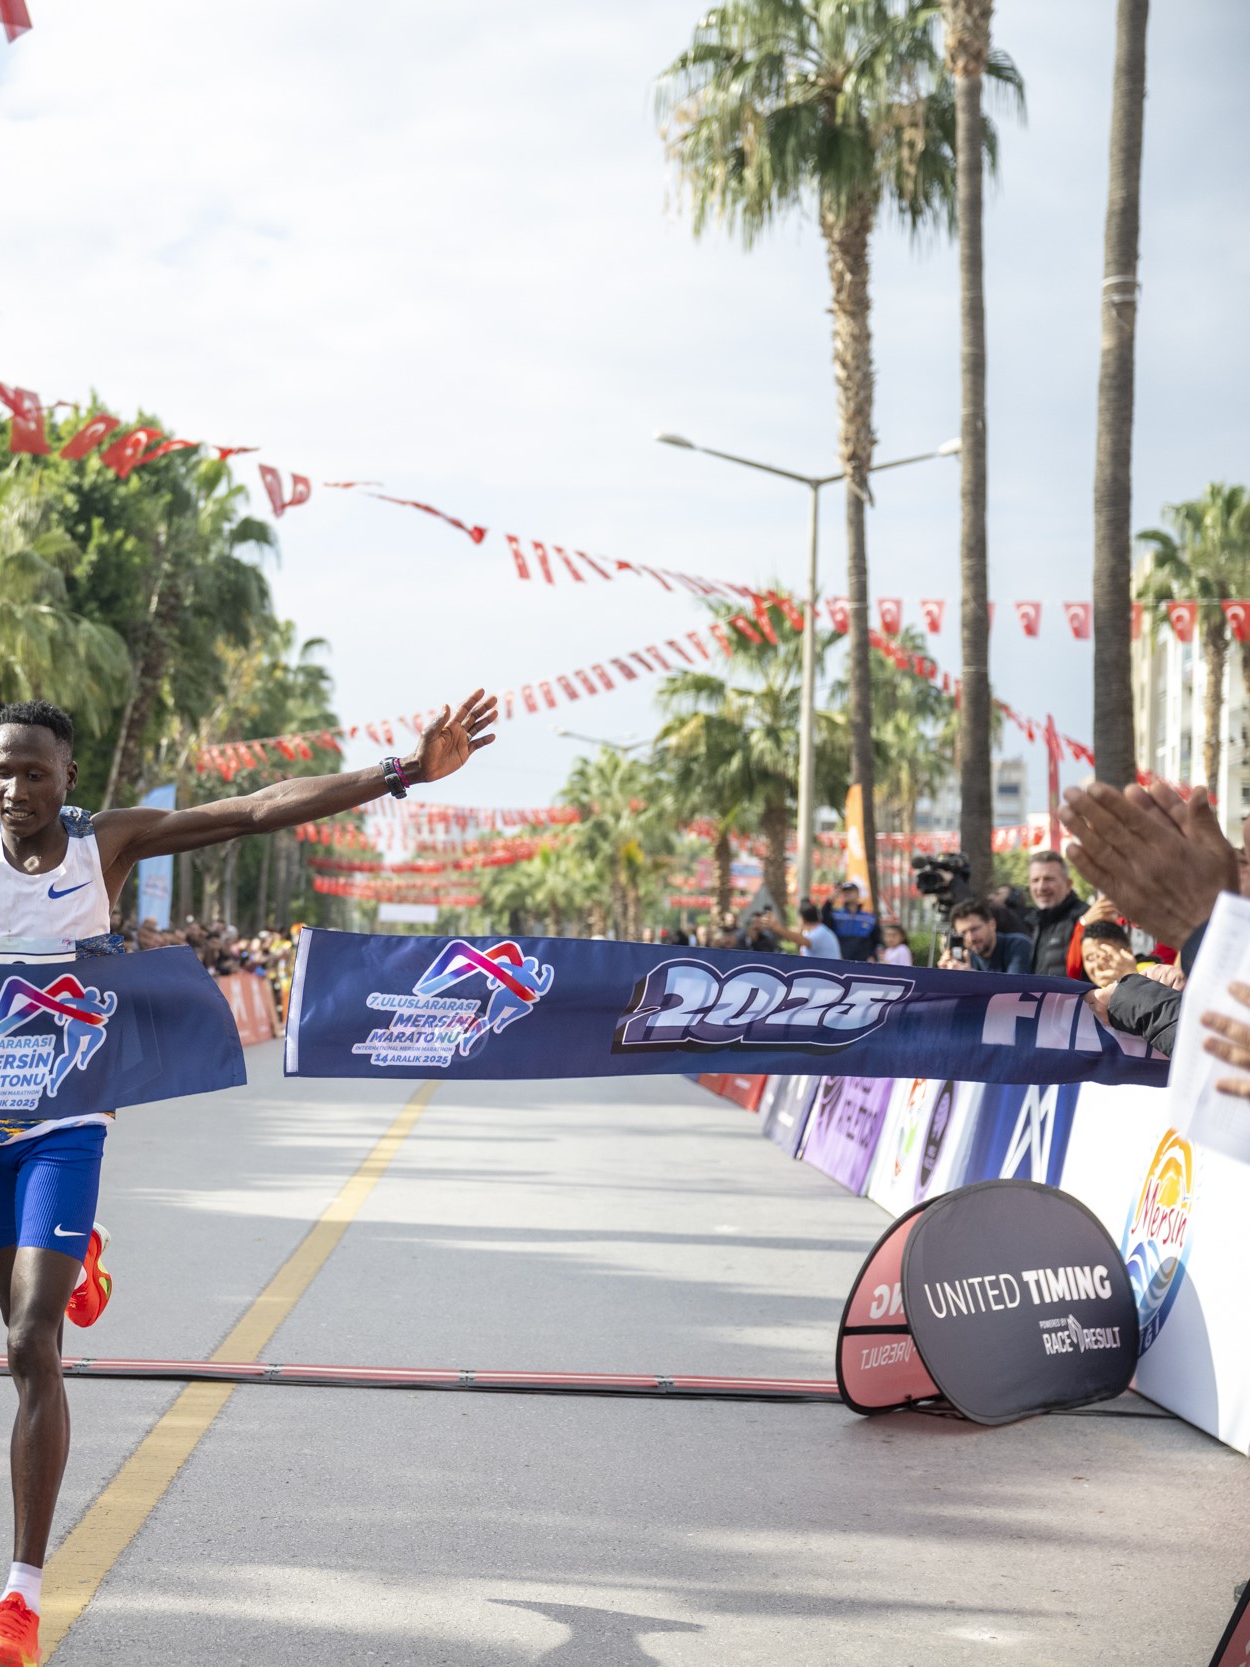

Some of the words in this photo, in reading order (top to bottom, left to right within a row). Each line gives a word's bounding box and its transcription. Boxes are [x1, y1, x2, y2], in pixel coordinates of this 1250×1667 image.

[369, 996, 478, 1011] 7.ULUSLARARASI
[645, 966, 906, 1030] 2025
[393, 1012, 471, 1029] MERSİN
[981, 992, 1170, 1060] FIN
[370, 1031, 461, 1043] MARATONU
[374, 1053, 389, 1064] 14
[390, 1055, 422, 1063] ARALIK
[423, 1055, 449, 1065] 2025
[9, 1098, 36, 1108] 2025
[923, 1273, 1021, 1319] UNITED
[1021, 1264, 1113, 1305] TIMING
[1042, 1330, 1073, 1355] RACE
[1082, 1326, 1121, 1350] RESULT
